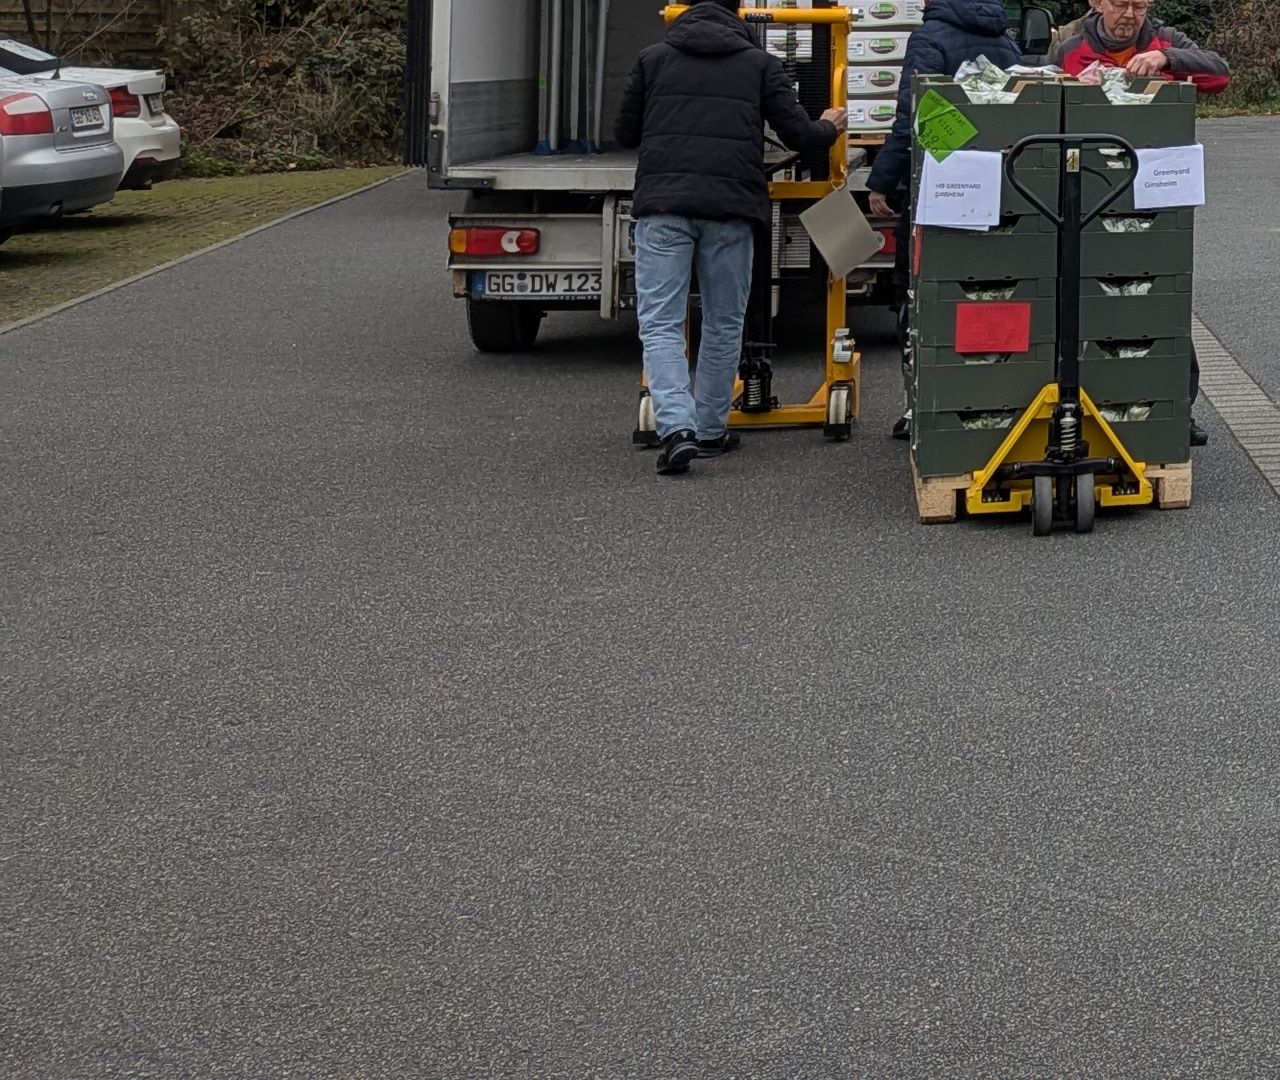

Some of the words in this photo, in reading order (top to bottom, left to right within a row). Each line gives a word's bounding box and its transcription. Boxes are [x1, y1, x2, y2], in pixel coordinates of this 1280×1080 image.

[1153, 167, 1190, 176] Greenyard
[1144, 180, 1178, 188] Ginsheim
[488, 274, 515, 293] GG
[530, 274, 558, 293] DW
[563, 273, 602, 293] 123
